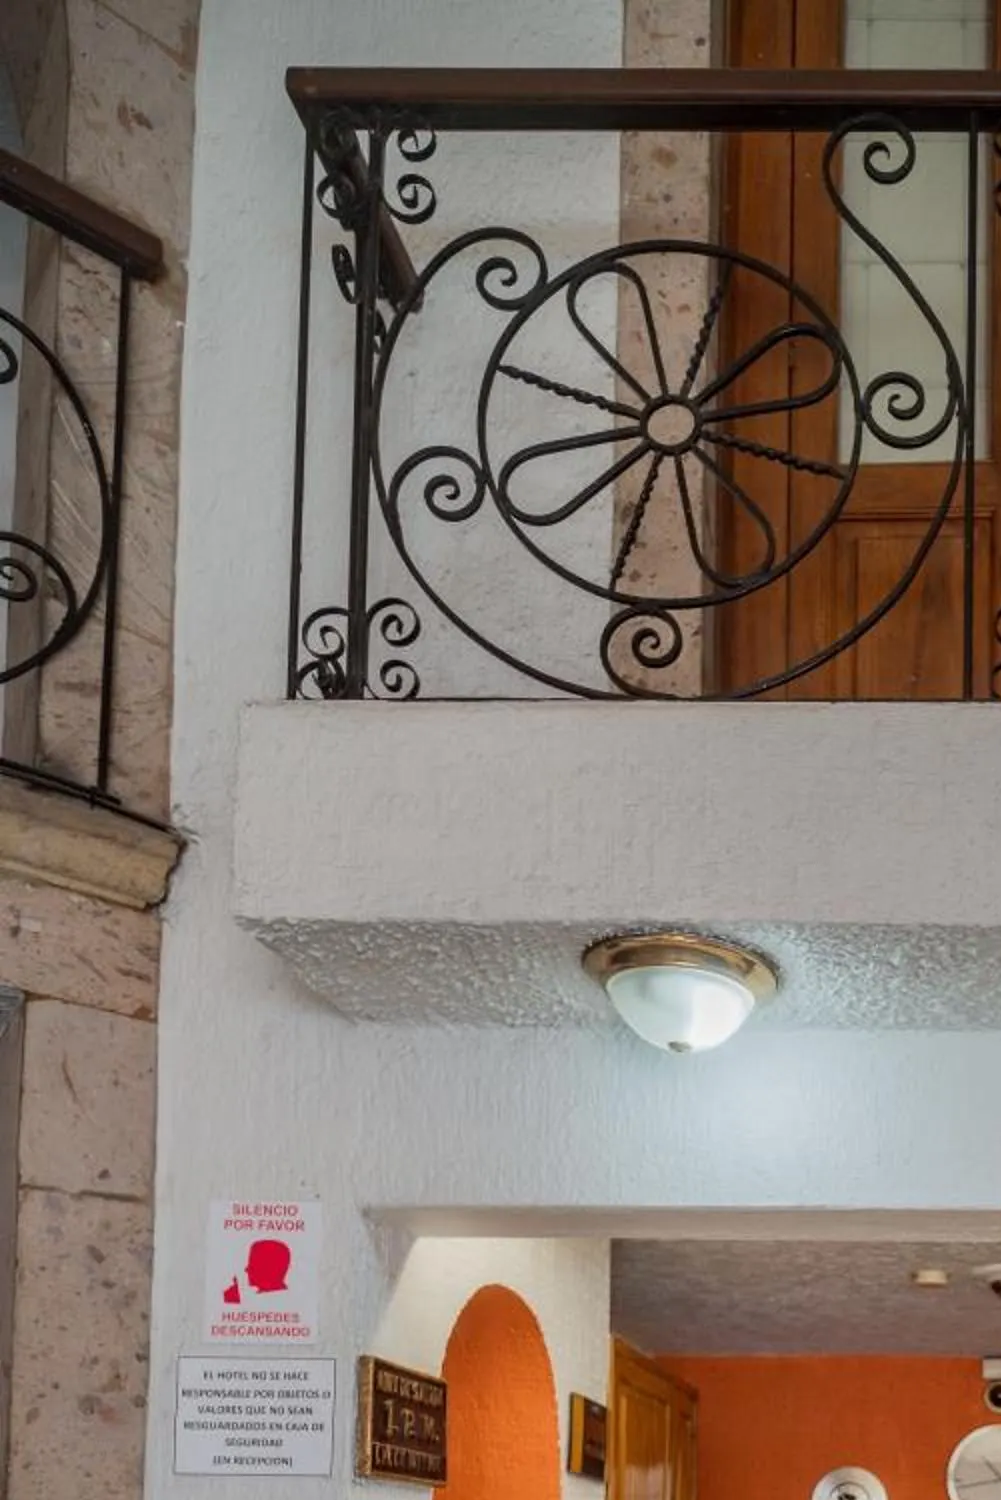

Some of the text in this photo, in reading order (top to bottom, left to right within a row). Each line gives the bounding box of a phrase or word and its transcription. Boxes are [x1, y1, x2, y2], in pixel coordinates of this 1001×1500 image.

[233, 1204, 299, 1217] SILENCIO
[223, 1219, 305, 1232] POR FAVOR
[211, 1326, 310, 1337] DESCANSANDO
[217, 1371, 248, 1381] HOTEL
[251, 1371, 267, 1381] NO
[269, 1372, 280, 1381] SE
[283, 1371, 309, 1381] HACE
[181, 1389, 250, 1399] RESPONSABLE
[253, 1389, 275, 1399] POR
[277, 1389, 319, 1399] OBJETOS
[197, 1405, 313, 1416] VALORES QUE NO SEAN
[183, 1421, 266, 1431] RESGUARDADOS
[269, 1422, 283, 1431] EN
[311, 1422, 324, 1432] DE
